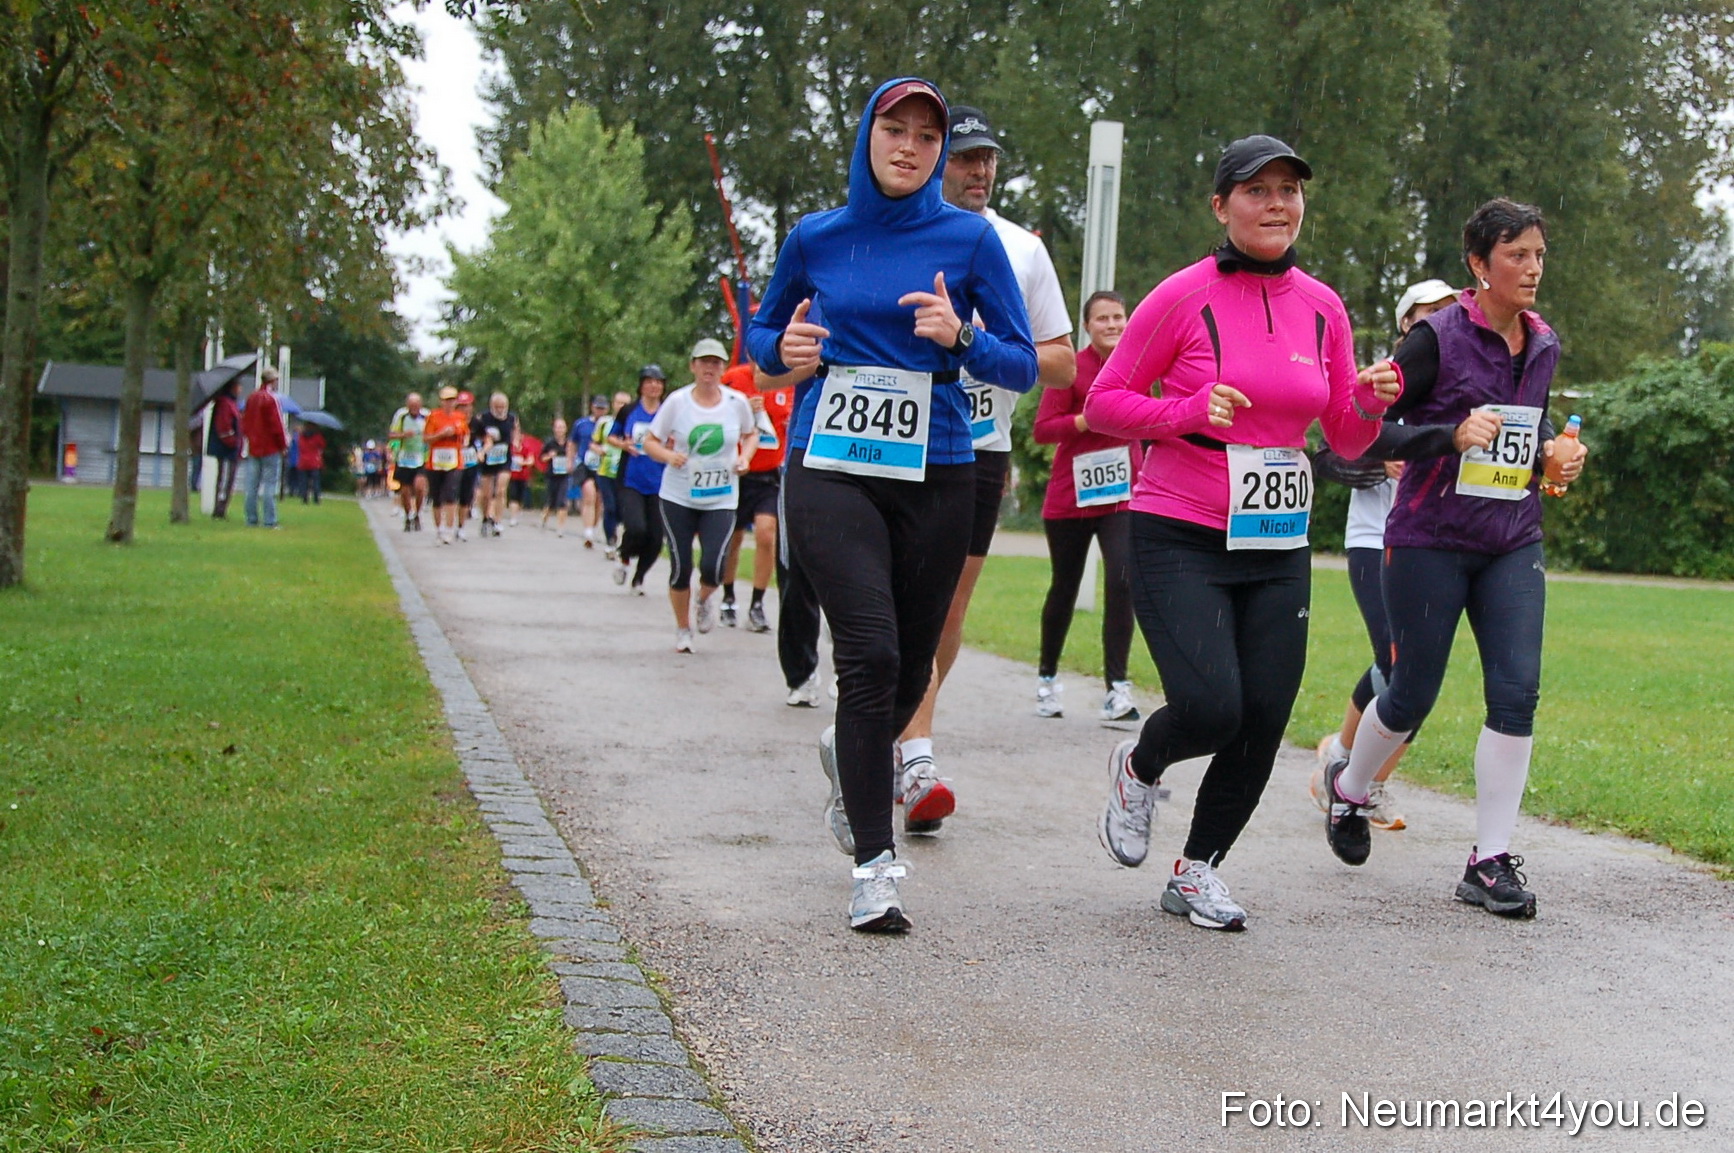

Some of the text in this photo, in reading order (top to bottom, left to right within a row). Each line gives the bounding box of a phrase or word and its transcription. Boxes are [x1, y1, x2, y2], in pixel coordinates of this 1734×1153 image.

[825, 392, 919, 438] 2849
[847, 442, 882, 463] Anja
[694, 469, 730, 487] 2779
[1081, 461, 1127, 488] 3055
[1241, 470, 1308, 510] 2850
